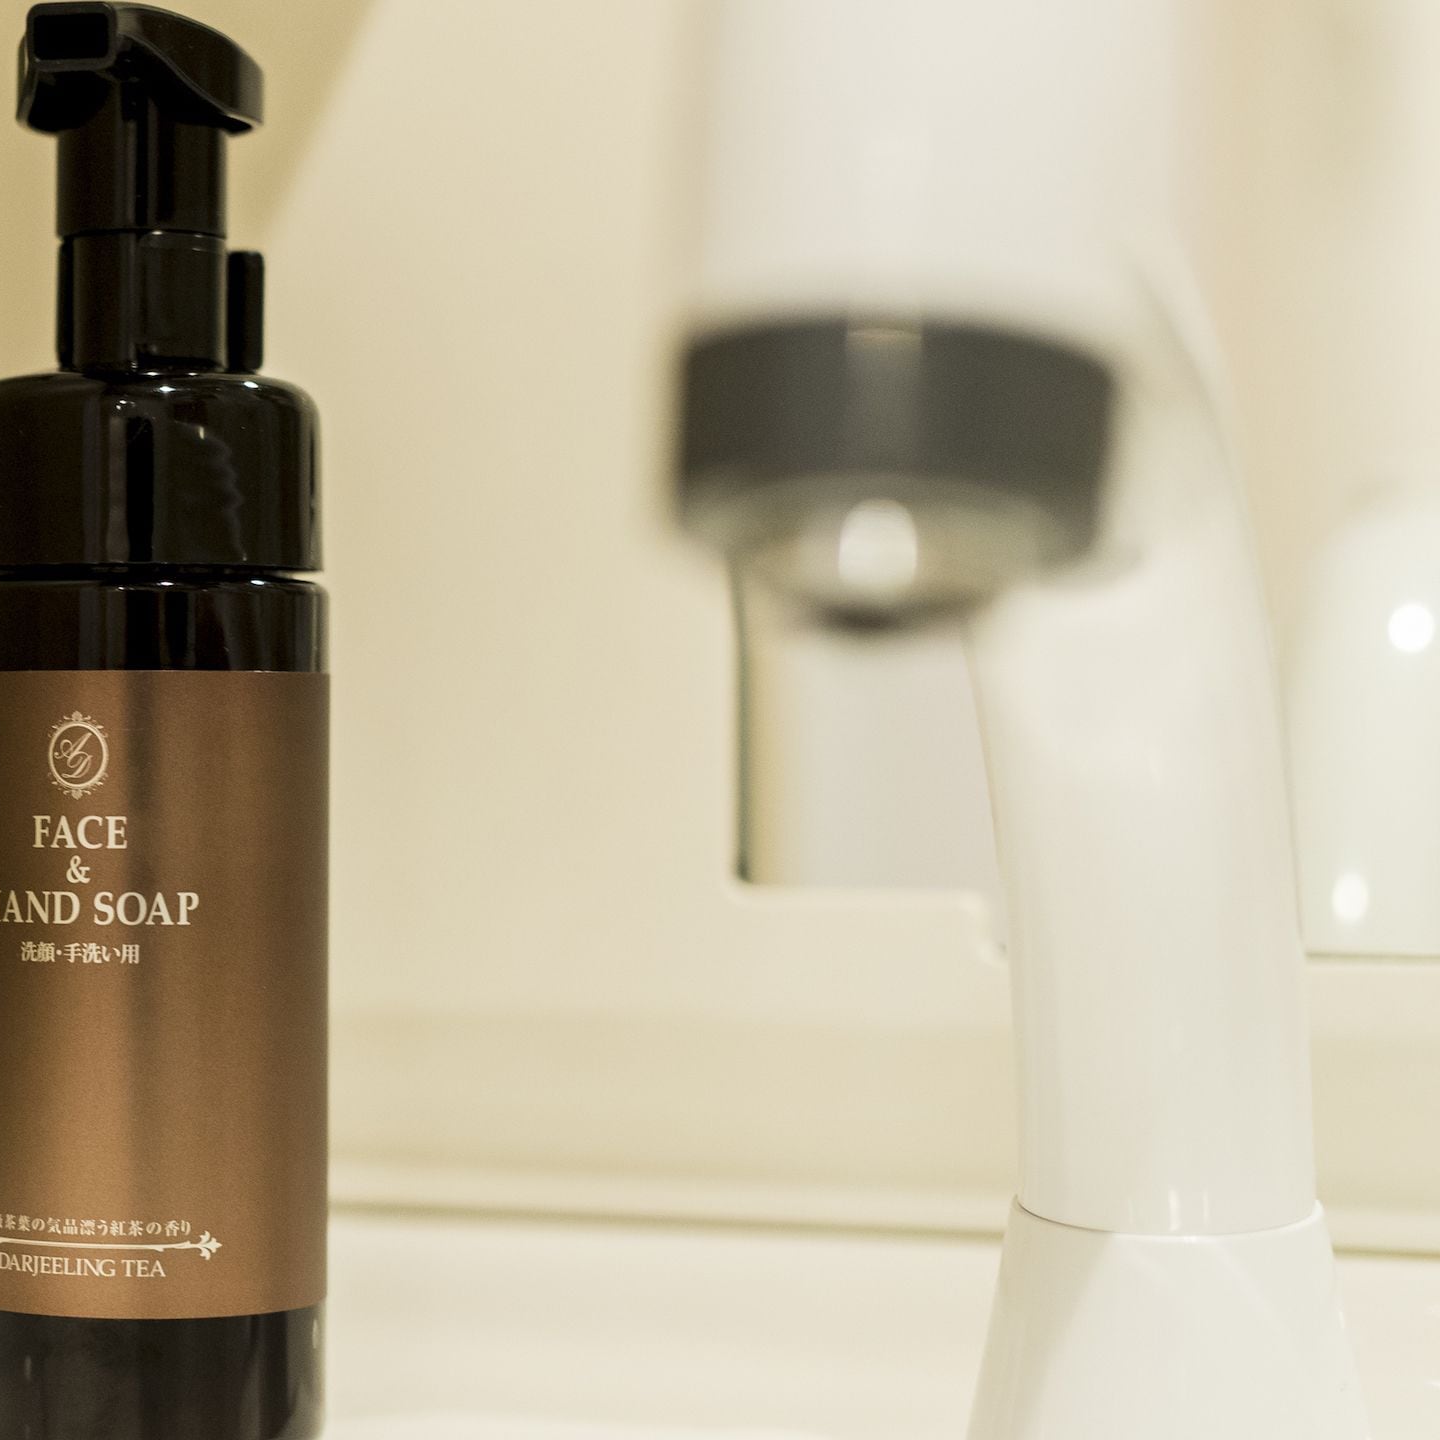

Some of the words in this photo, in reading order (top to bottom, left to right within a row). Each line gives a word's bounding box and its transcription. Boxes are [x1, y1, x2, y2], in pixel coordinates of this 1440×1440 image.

[32, 814, 128, 850] FACE
[65, 855, 91, 884] &
[93, 891, 200, 926] SOAP
[122, 1259, 167, 1278] TEA
